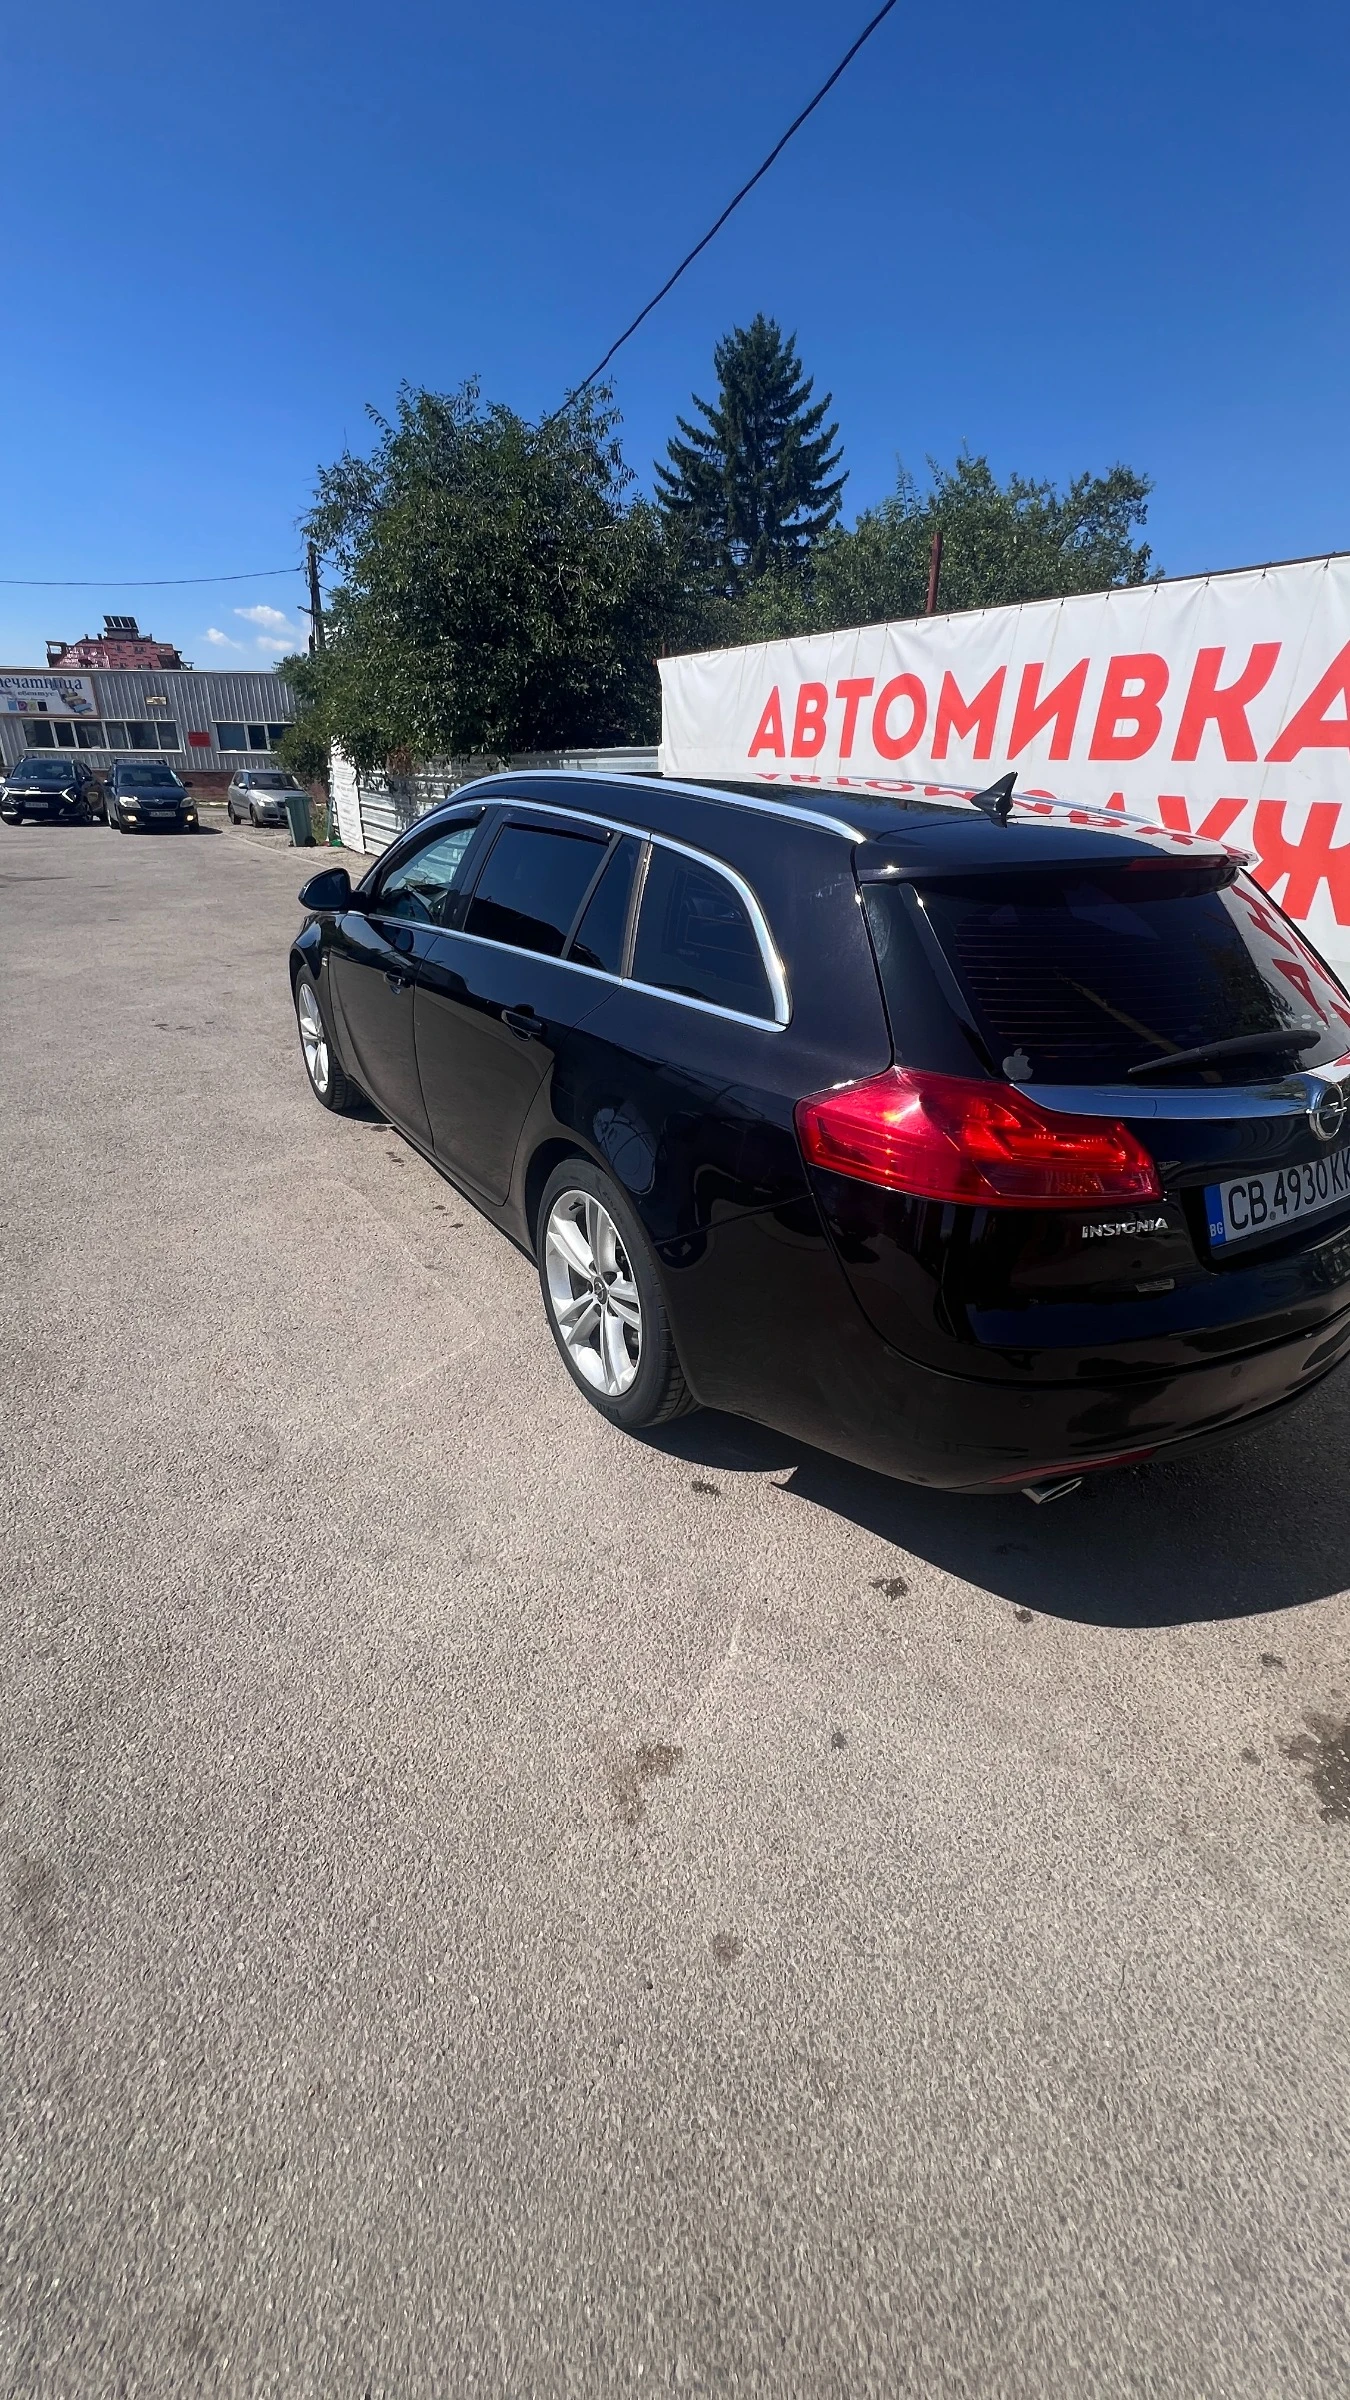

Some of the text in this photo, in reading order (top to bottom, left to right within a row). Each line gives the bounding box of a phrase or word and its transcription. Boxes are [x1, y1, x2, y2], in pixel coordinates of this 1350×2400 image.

[747, 637, 1350, 763] АВТОМИВКА
[1082, 1217, 1168, 1238] INSIGNIA
[1209, 1221, 1224, 1237] BG
